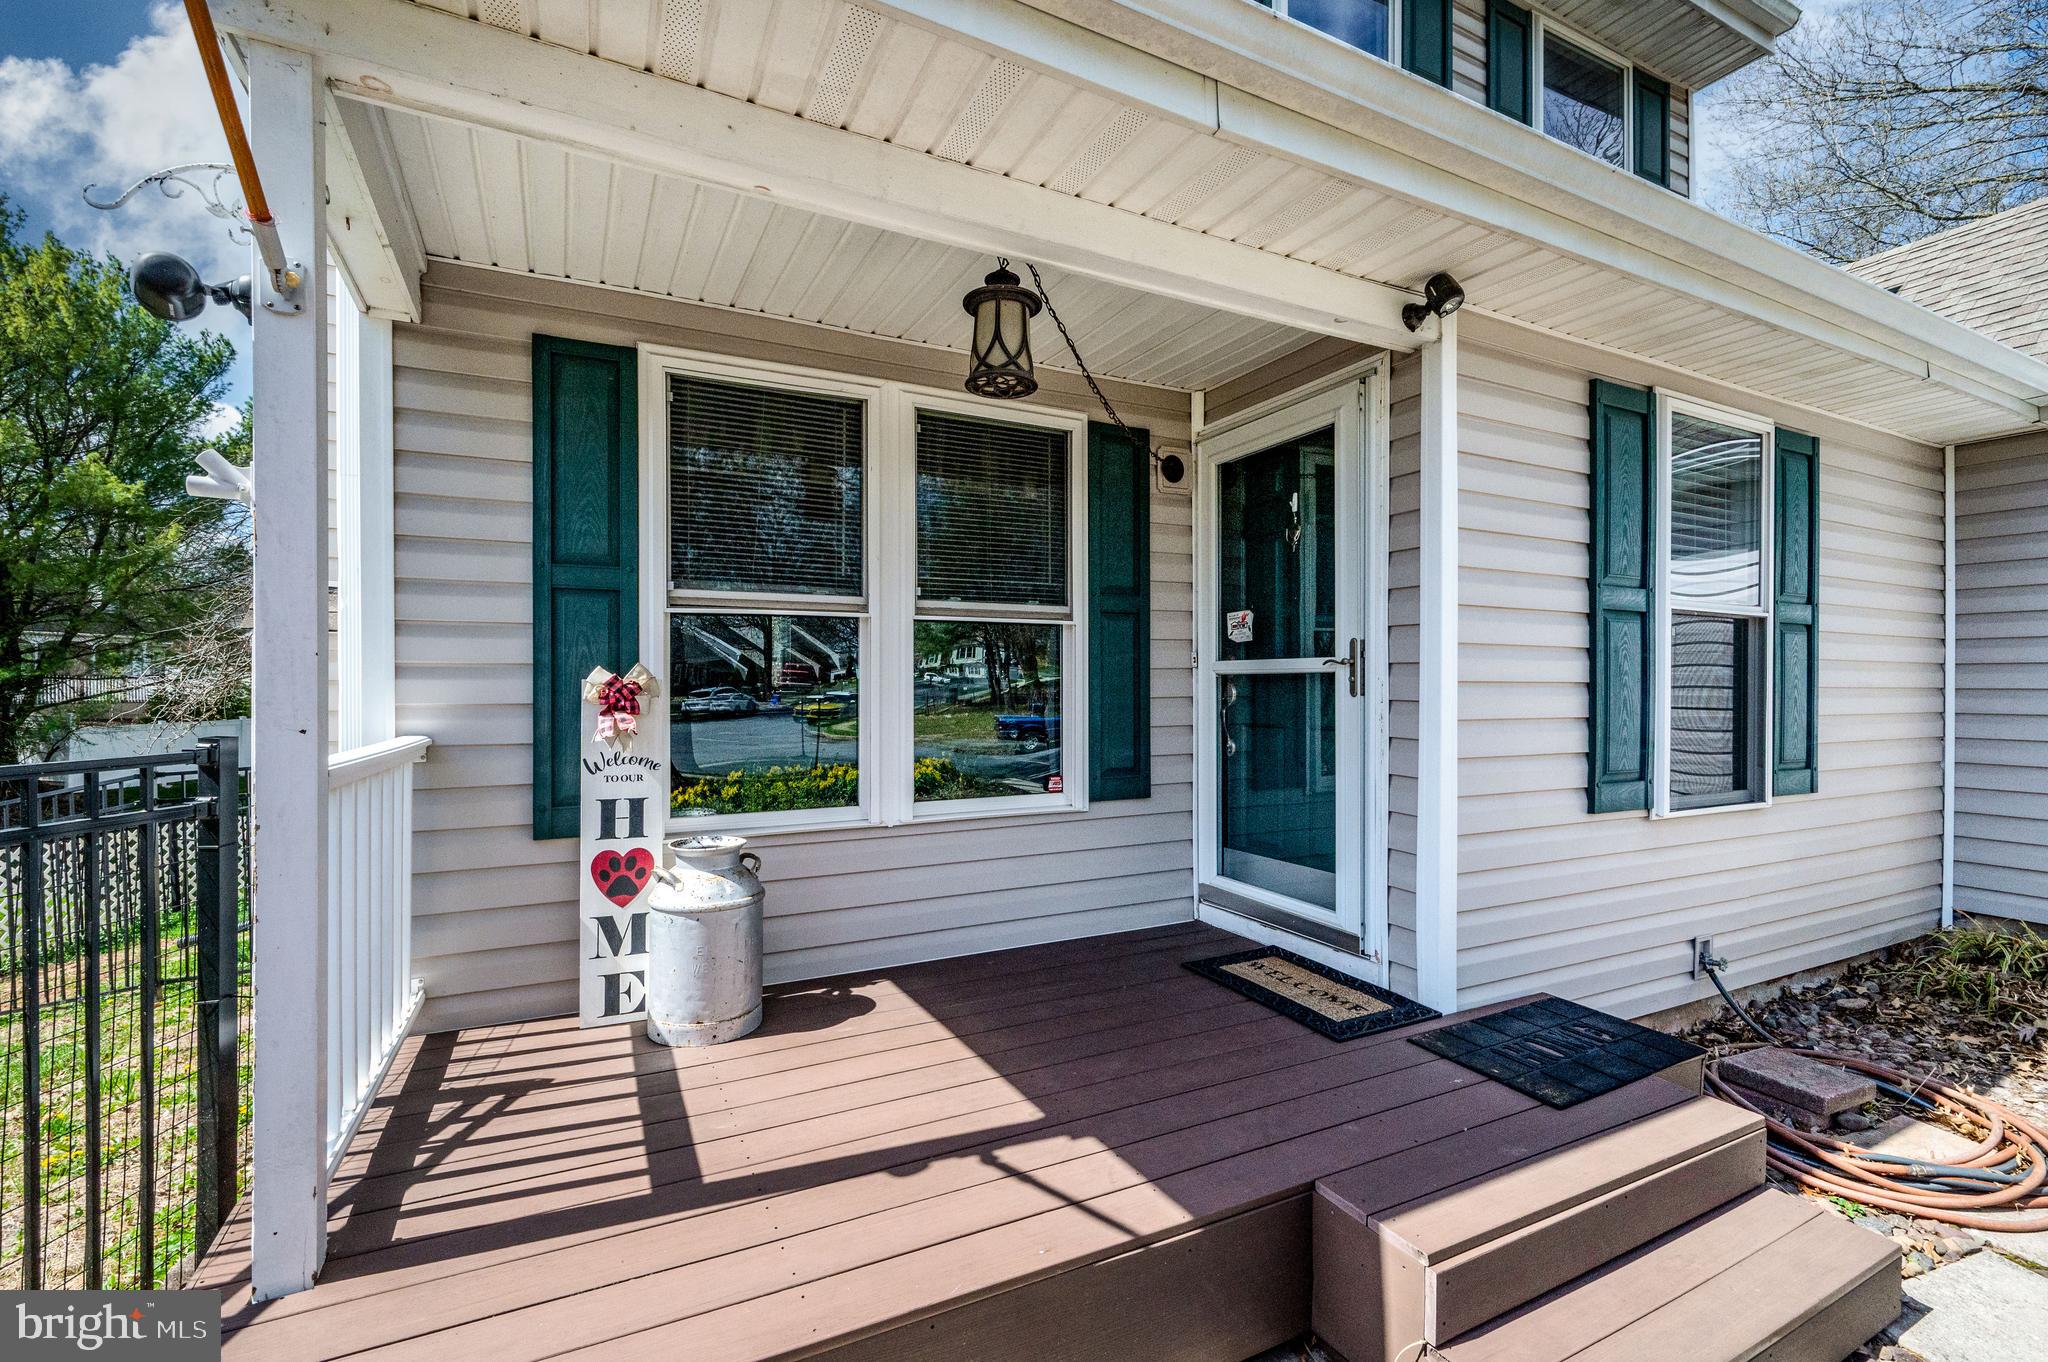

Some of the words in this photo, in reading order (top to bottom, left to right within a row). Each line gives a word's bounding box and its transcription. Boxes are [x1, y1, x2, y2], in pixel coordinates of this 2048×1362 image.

[582, 751, 662, 775] Welcome
[604, 775, 619, 783] TO
[621, 774, 644, 783] OUR
[1247, 961, 1370, 1012] WELCOME
